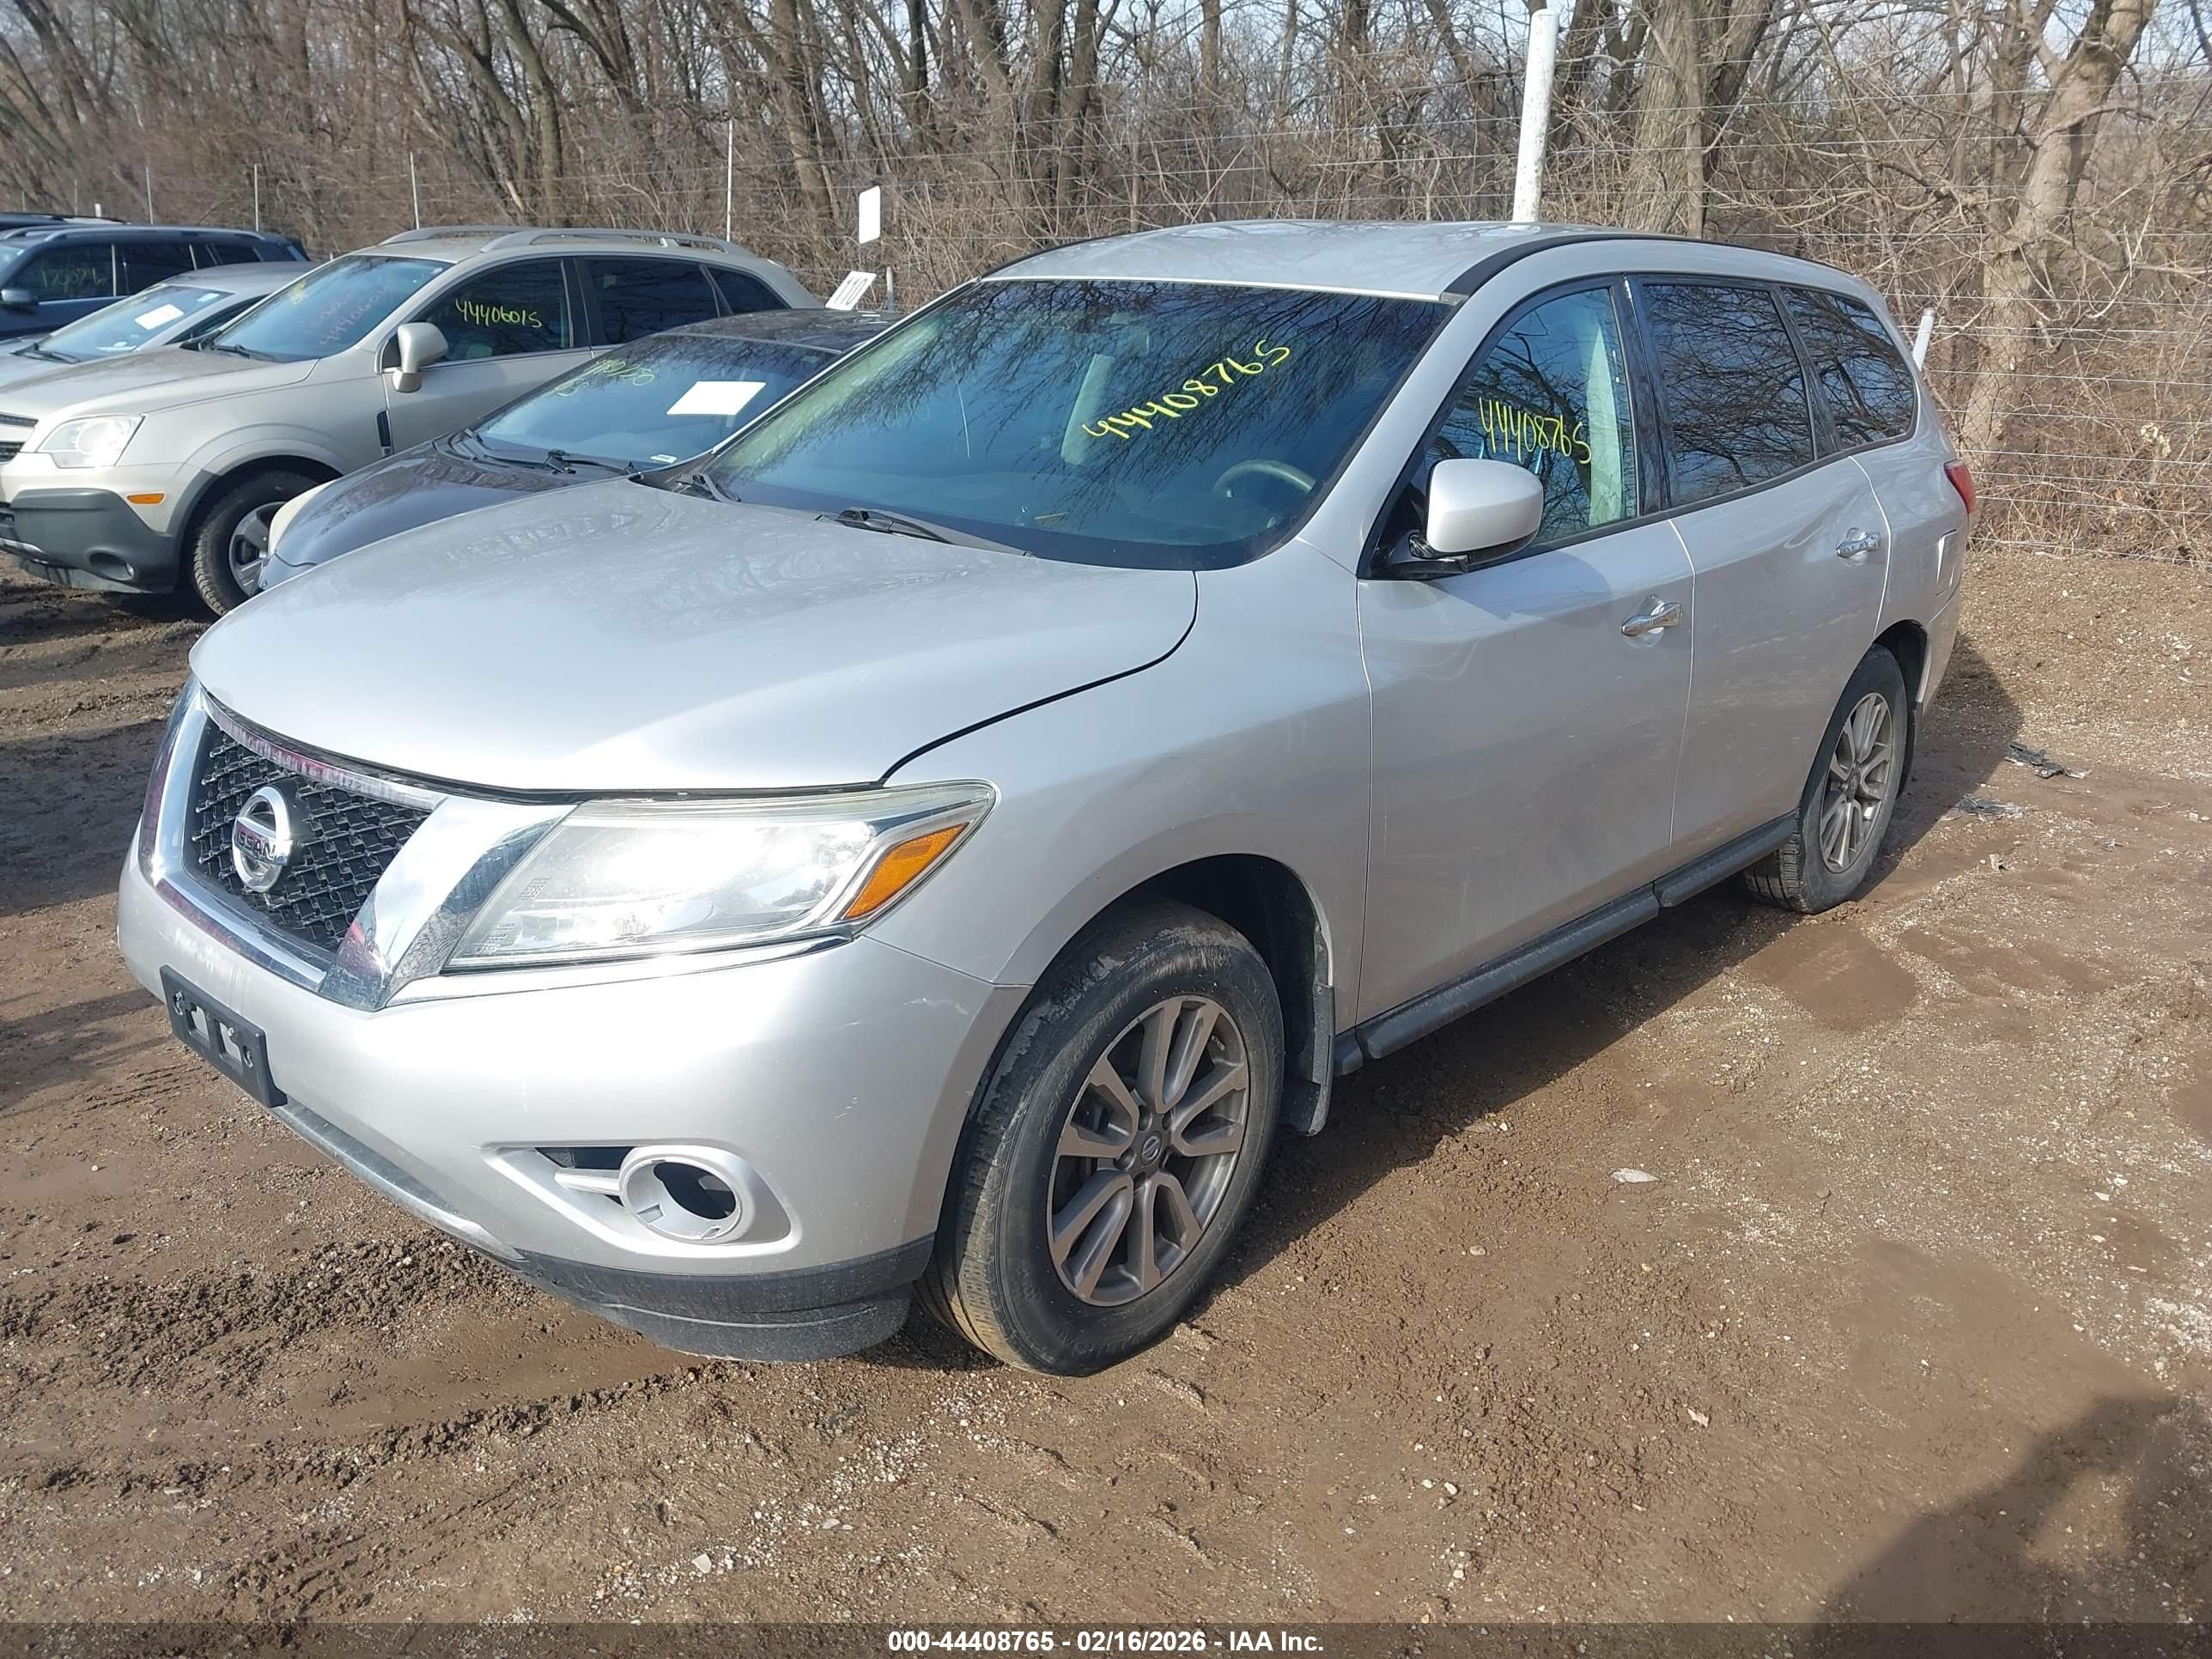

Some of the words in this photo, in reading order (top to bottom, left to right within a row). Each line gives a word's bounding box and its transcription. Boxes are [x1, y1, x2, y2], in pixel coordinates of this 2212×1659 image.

[455, 298, 543, 328] 44406015
[835, 276, 868, 307] 110
[1082, 338, 1291, 440] 44408765
[1479, 396, 1592, 465] 44408765
